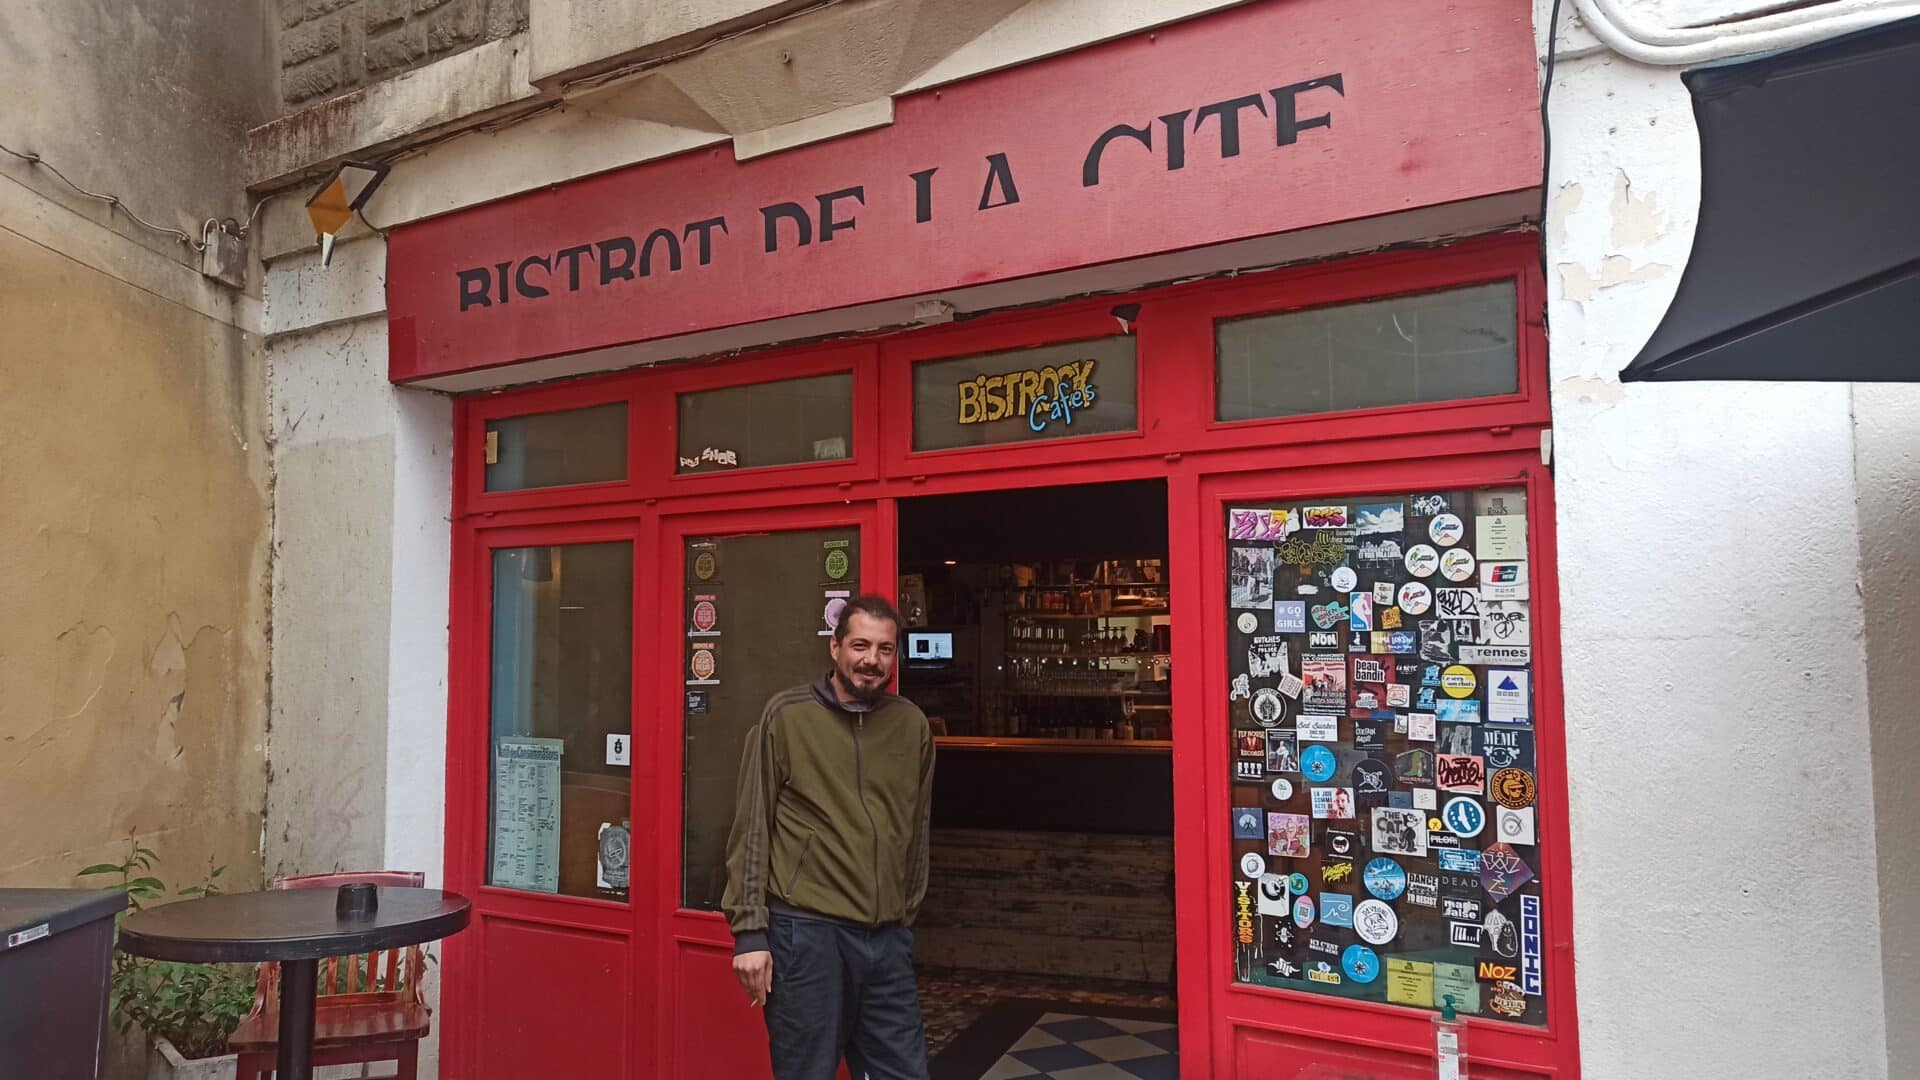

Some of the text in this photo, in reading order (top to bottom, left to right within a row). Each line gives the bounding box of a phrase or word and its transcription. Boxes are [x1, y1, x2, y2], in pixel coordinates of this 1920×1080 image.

[1277, 620, 1304, 628] GIRLS
[1477, 649, 1527, 657] rennes
[1356, 660, 1377, 671] beau
[1356, 670, 1384, 681] bandit
[1383, 810, 1400, 820] THE
[1376, 817, 1401, 834] CAT
[1409, 873, 1437, 886] DANCE
[1442, 877, 1478, 887] DEAD
[1415, 894, 1437, 906] RESIST
[1235, 881, 1253, 944] VISITORS
[1523, 896, 1540, 994] SONIC
[1479, 962, 1517, 980] NOZ
